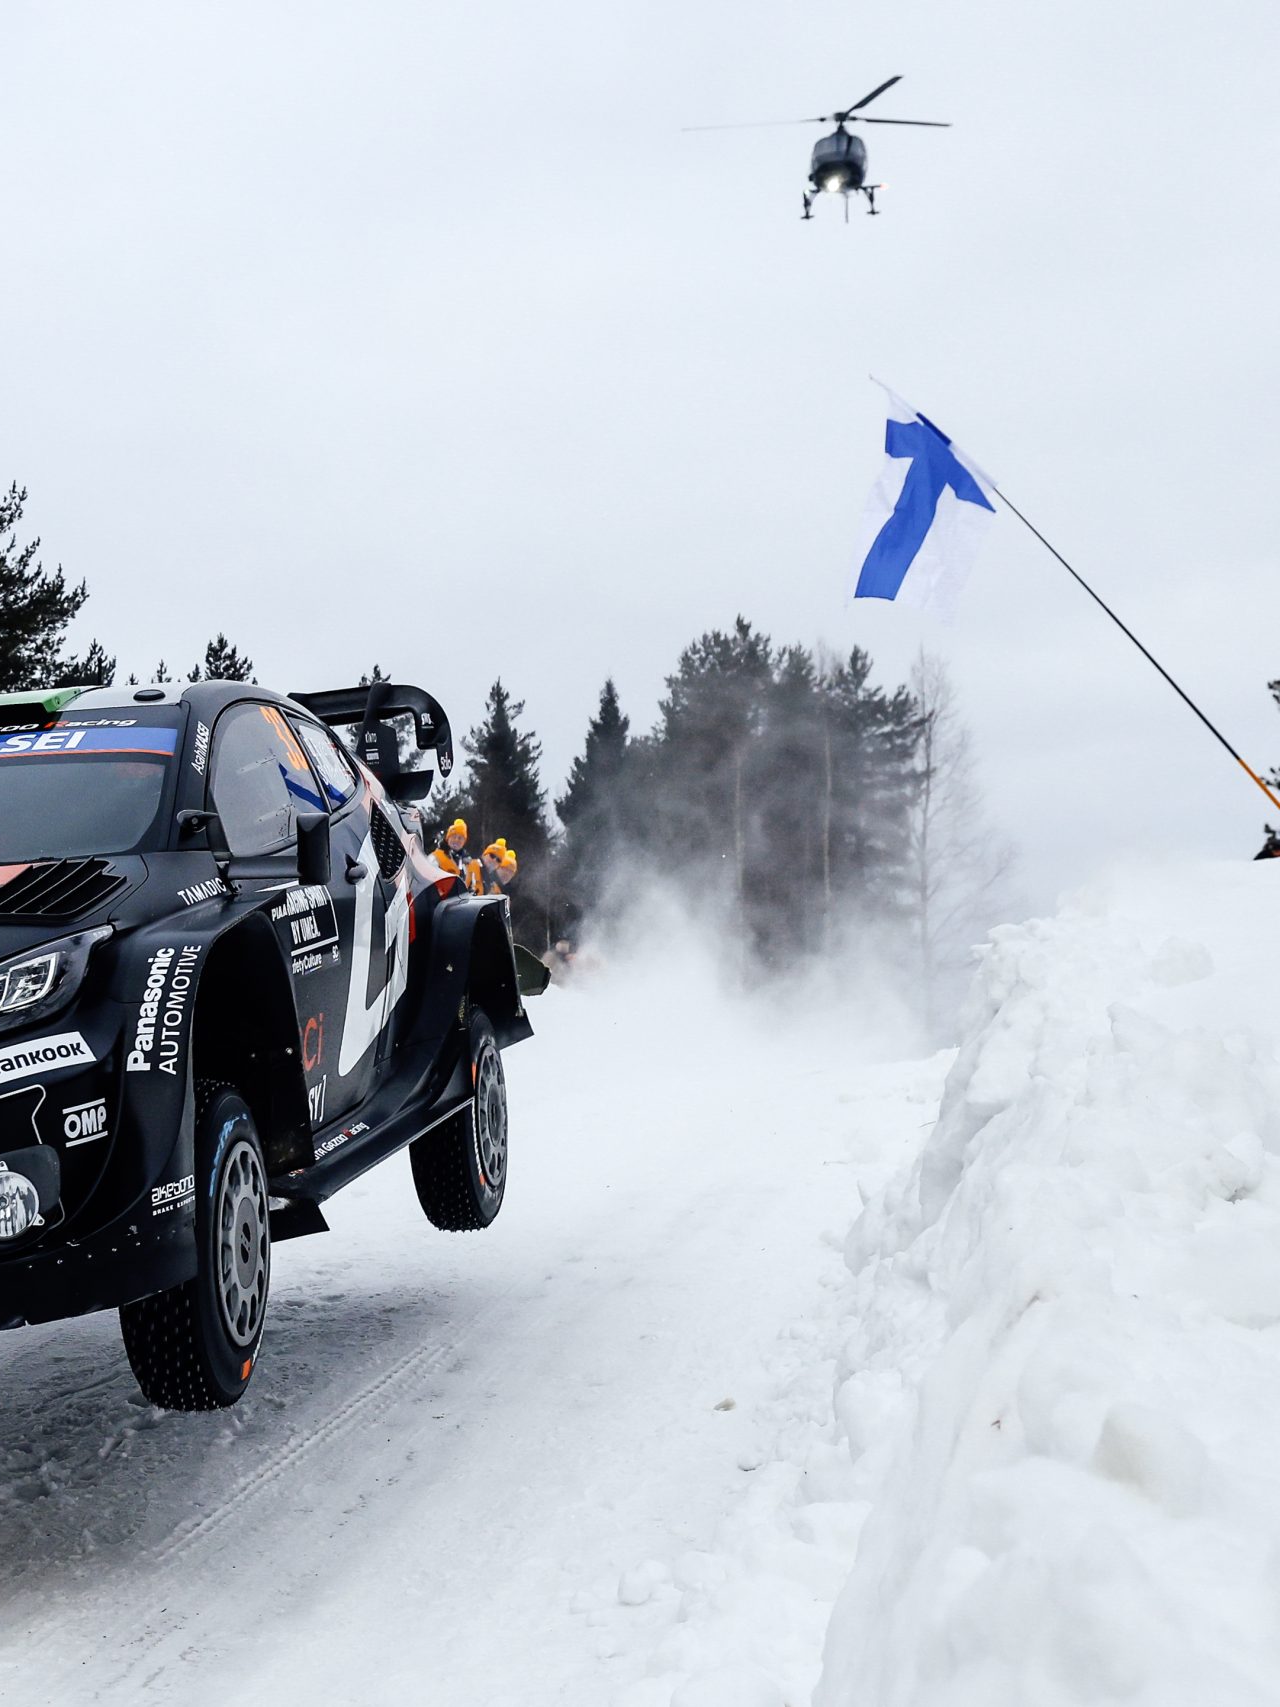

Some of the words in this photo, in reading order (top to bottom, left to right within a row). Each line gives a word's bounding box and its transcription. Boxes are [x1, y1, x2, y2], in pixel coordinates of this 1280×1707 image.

[44, 719, 138, 730] Racing
[191, 720, 210, 776] AsahiKASEI
[177, 878, 227, 906] TAMADIC
[291, 919, 301, 945] BY
[126, 947, 175, 1072] Panasonic
[158, 945, 202, 1075] AUTOMOTIVE
[64, 1105, 107, 1140] OMP
[152, 1204, 174, 1216] BRAKE
